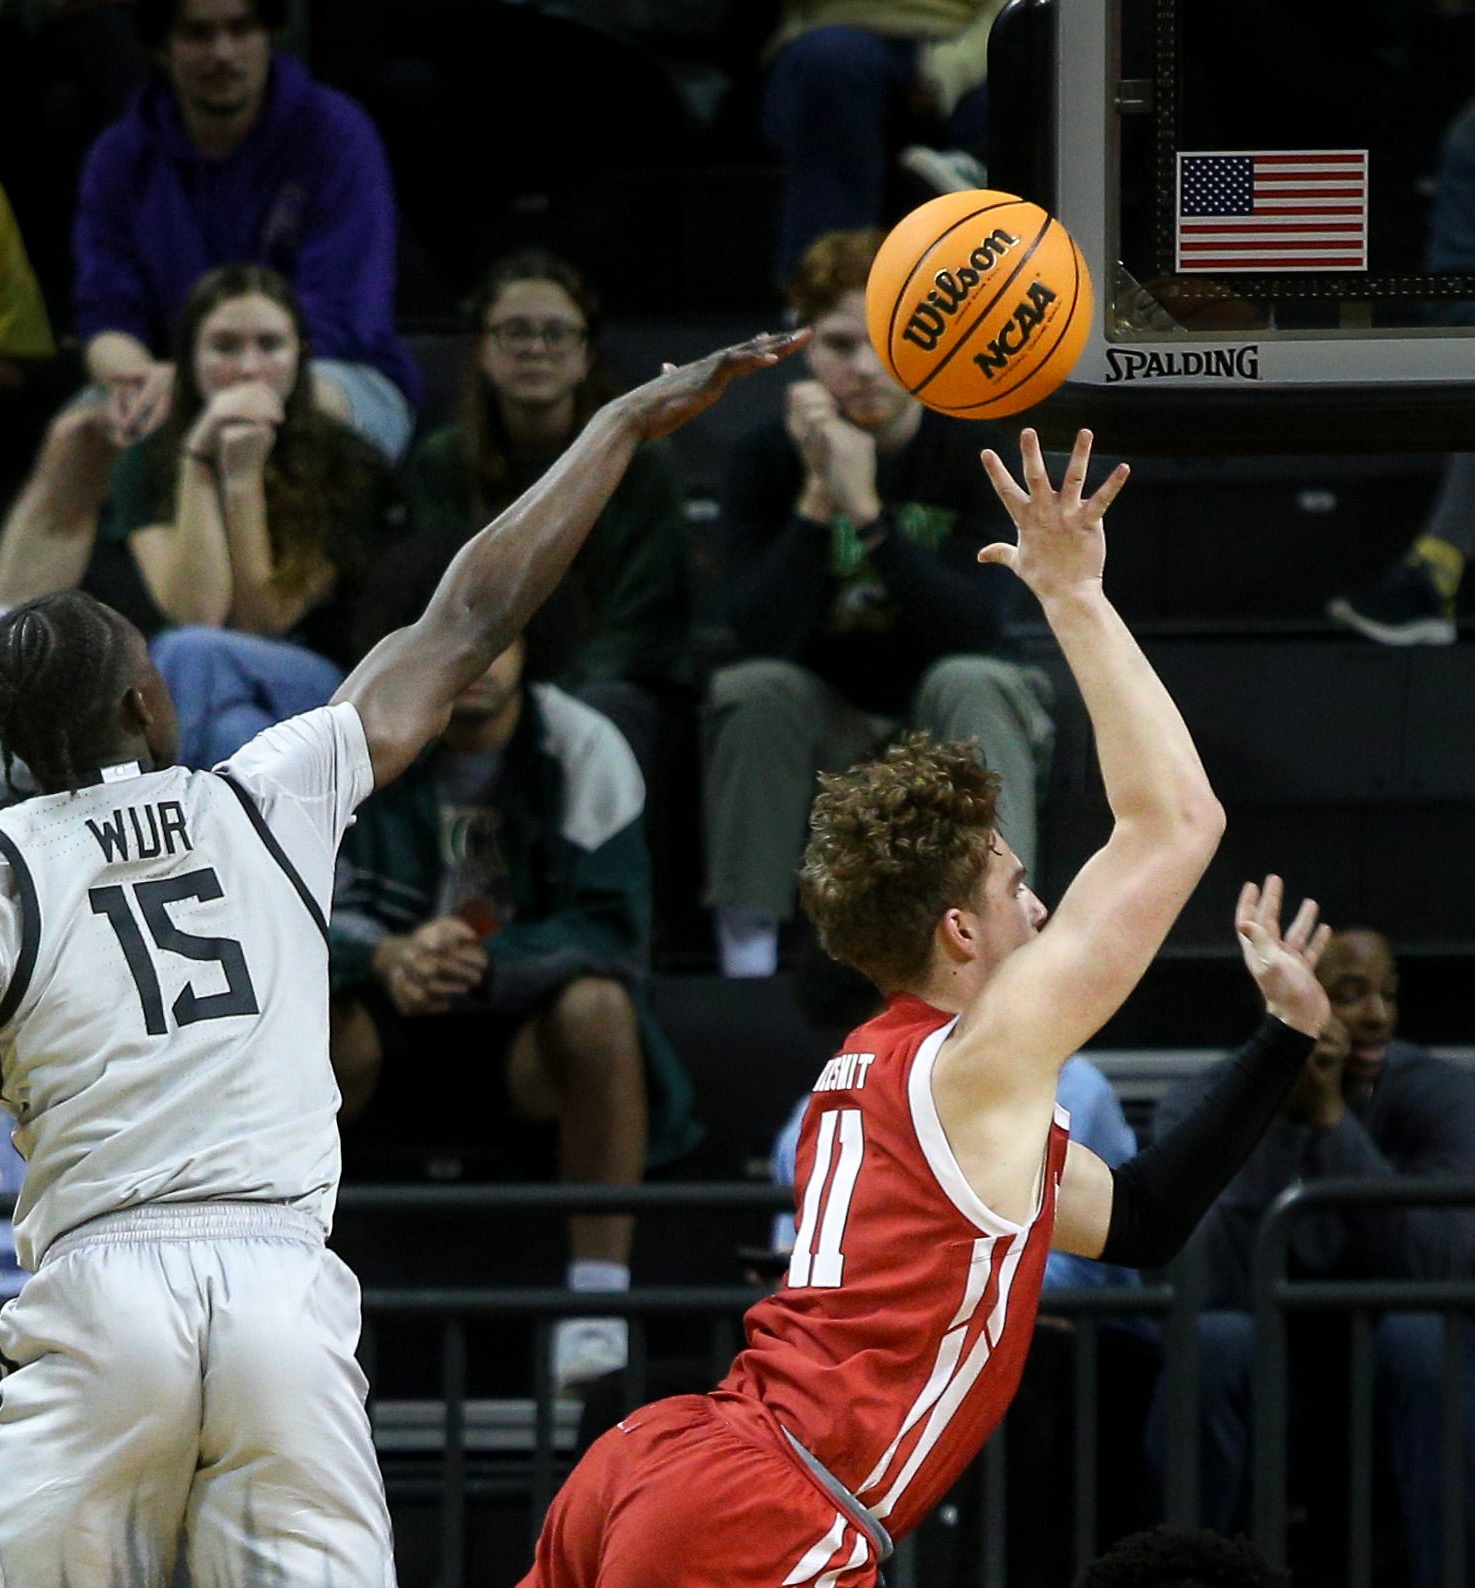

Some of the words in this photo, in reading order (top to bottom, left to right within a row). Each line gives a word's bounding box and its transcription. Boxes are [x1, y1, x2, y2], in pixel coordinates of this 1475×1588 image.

[902, 228, 1021, 352] Wilson
[973, 281, 1057, 380] NCAA
[1105, 345, 1259, 383] SPALDING
[84, 801, 194, 863] WUR
[88, 867, 261, 1036] 15
[788, 1109, 864, 1288] 11
